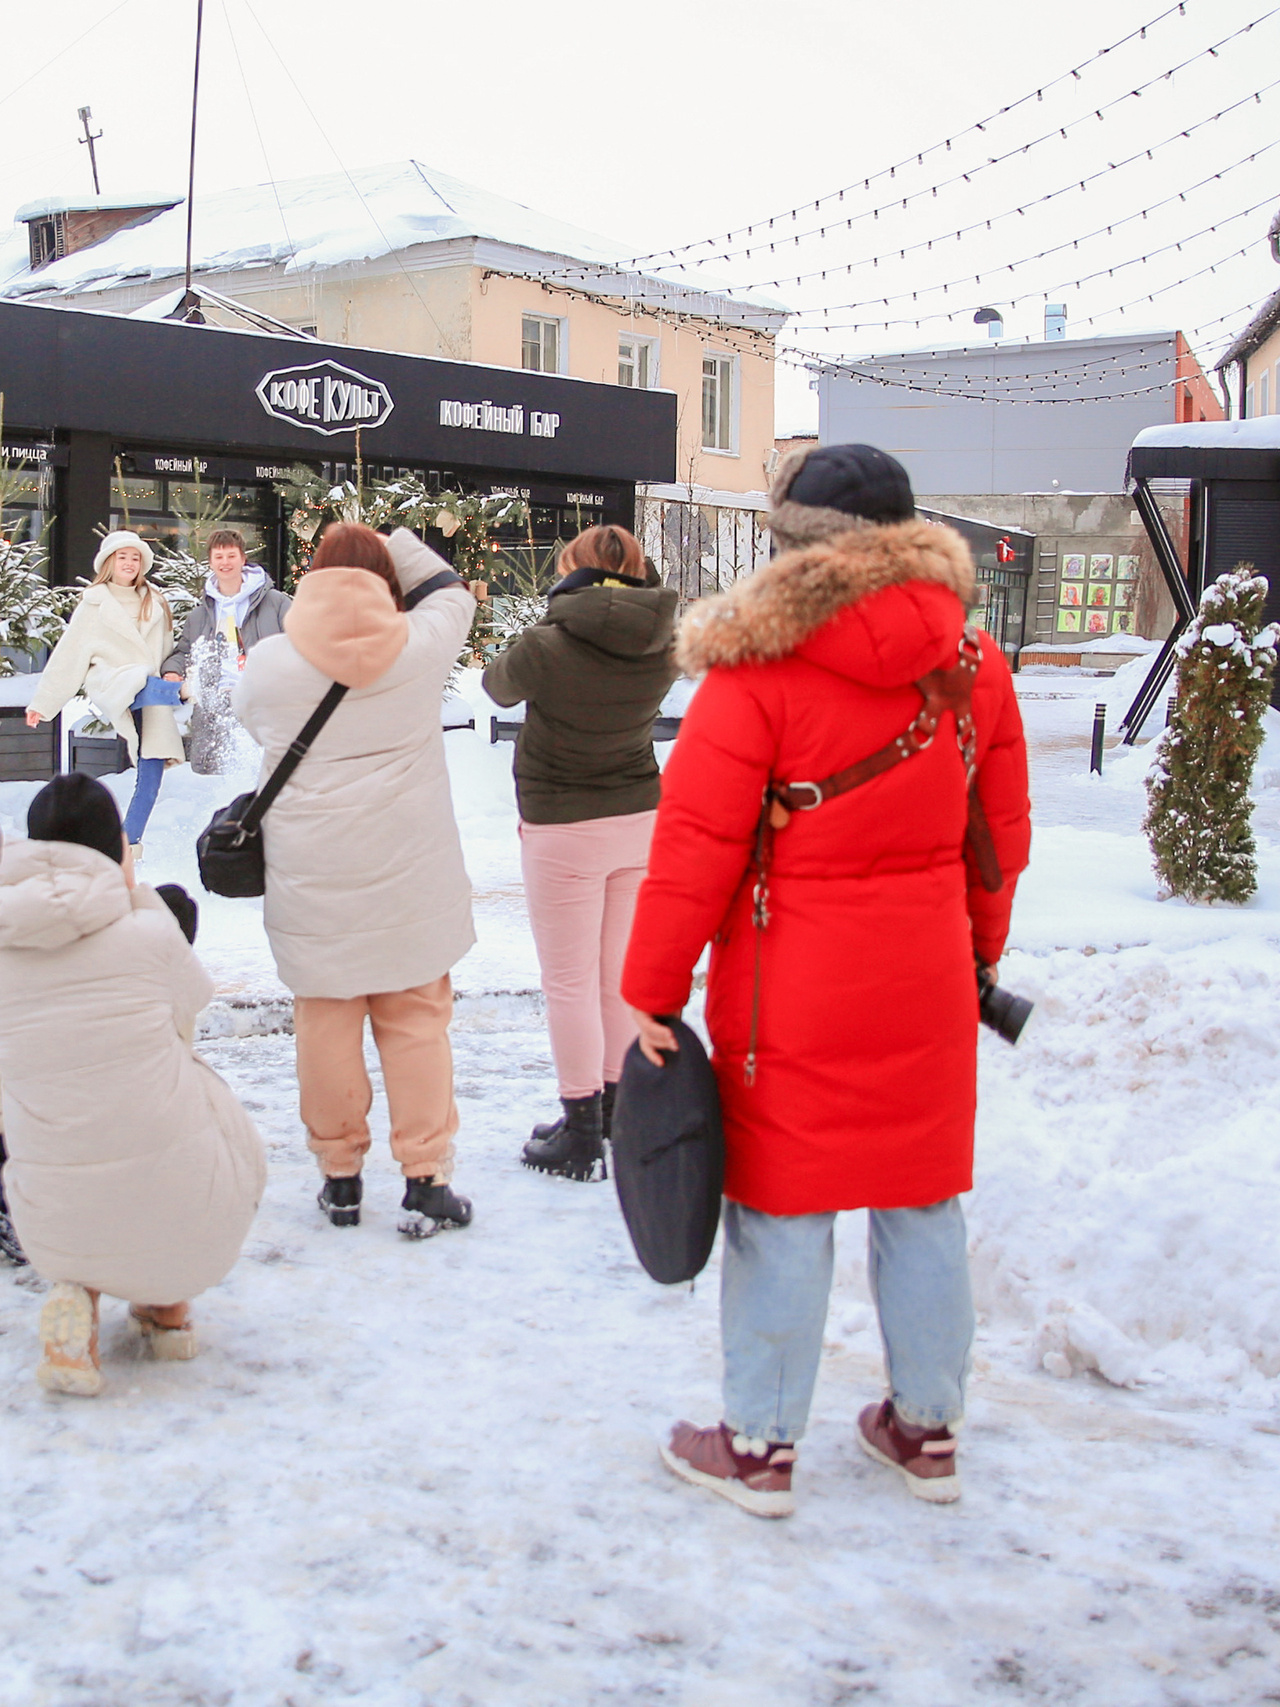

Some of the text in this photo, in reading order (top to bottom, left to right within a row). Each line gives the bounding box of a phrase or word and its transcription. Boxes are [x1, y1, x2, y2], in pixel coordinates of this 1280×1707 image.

[270, 375, 382, 423] КОФЕ КУЛЬТ
[439, 399, 561, 438] КОФЕЙНЫЙ БАР
[1, 445, 9, 458] и
[11, 446, 47, 462] пицца
[155, 457, 193, 473] КОФЕЙНЫЙ
[594, 495, 604, 506] БАР
